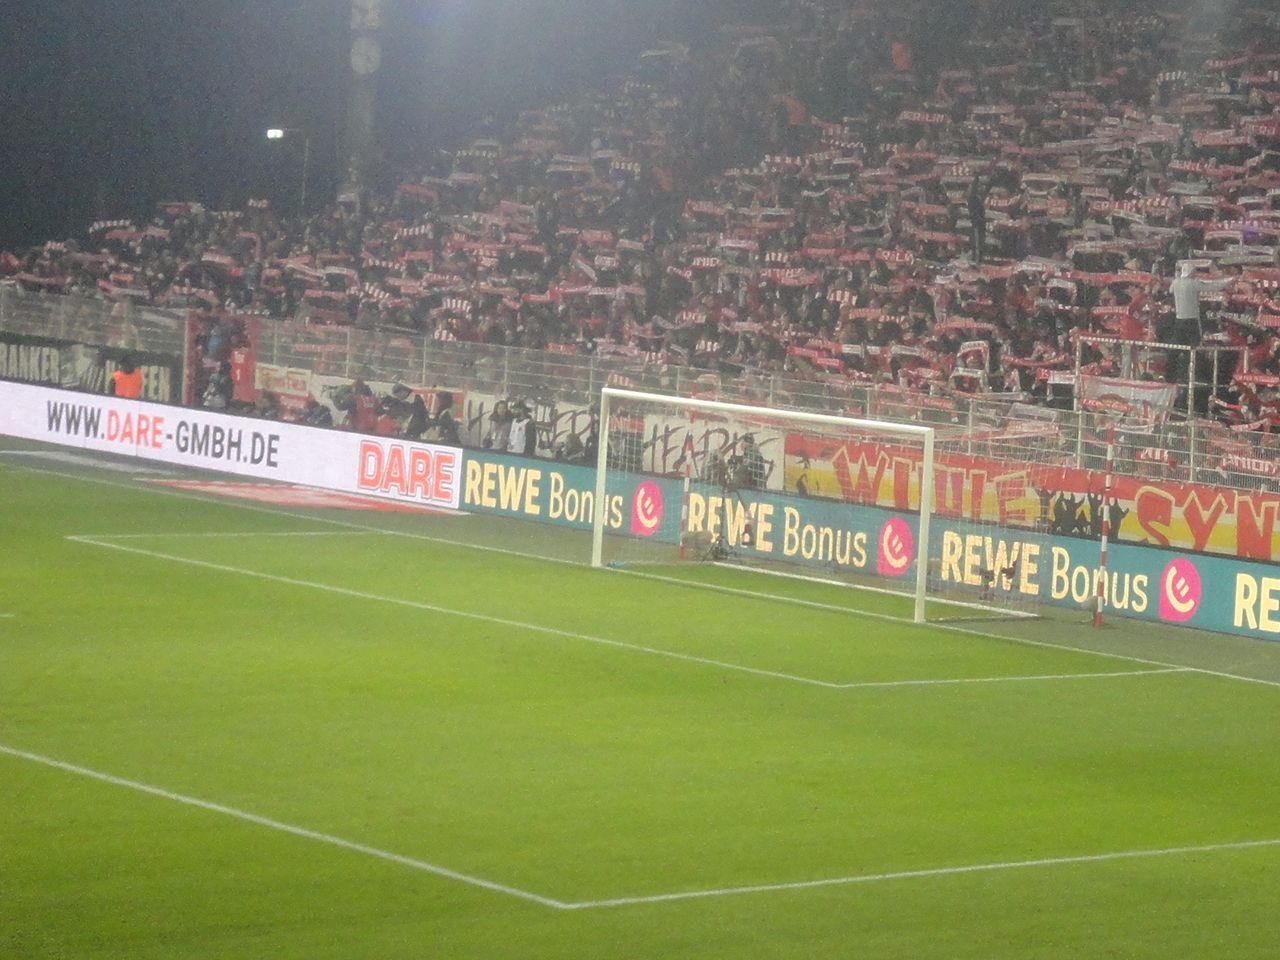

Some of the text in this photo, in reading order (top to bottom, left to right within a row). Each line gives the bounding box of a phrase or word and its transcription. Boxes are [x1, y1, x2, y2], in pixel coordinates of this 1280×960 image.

[47, 400, 280, 468] WWW.DARE-GMBH.DE
[357, 440, 456, 503] DARE
[465, 459, 624, 529] REWE Bonus
[688, 492, 868, 568] REWE Bonus
[941, 530, 1150, 613] REWE Bonus
